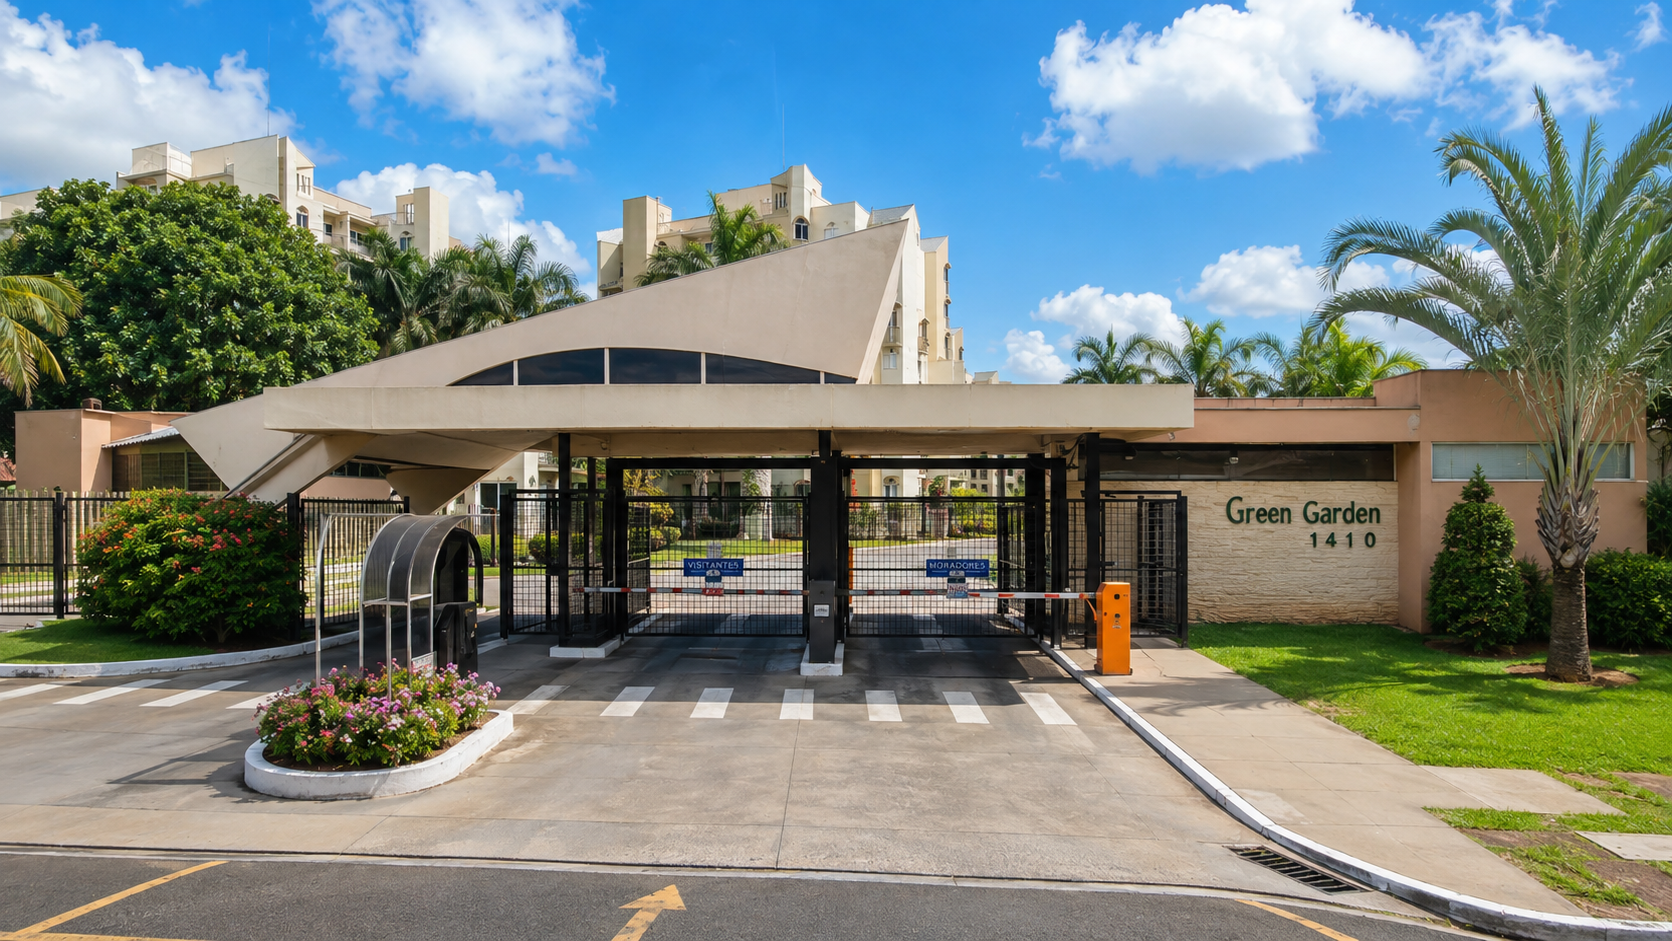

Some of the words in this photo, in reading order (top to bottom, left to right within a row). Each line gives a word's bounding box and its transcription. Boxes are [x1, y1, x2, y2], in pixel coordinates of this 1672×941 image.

[1226, 496, 1292, 523] Green
[1304, 501, 1381, 523] Garden
[1310, 532, 1376, 547] 1410
[688, 561, 739, 569] VISITANTES
